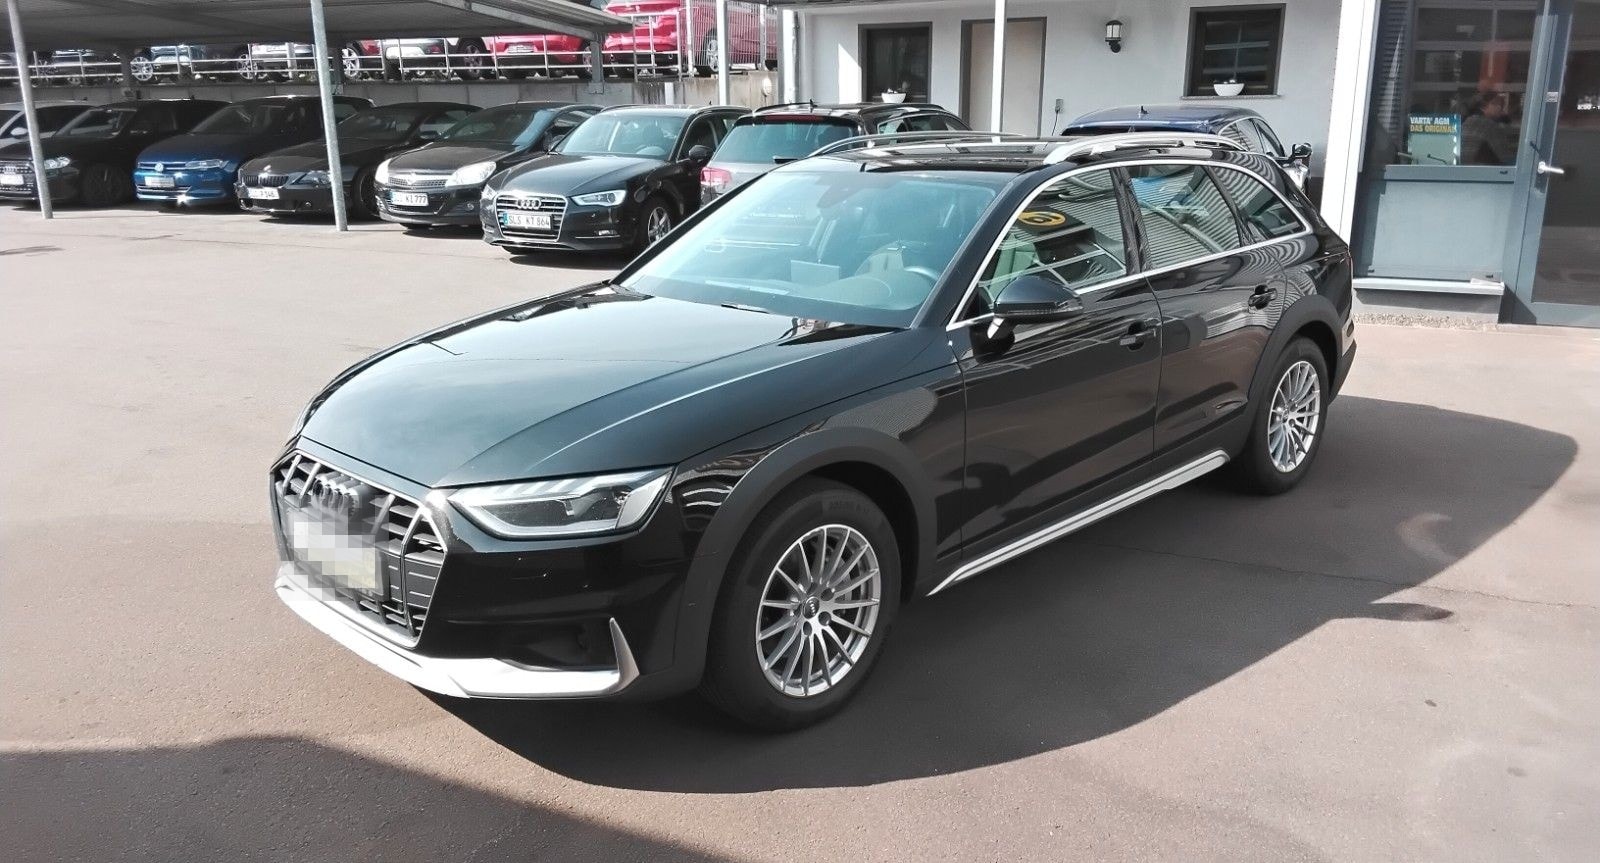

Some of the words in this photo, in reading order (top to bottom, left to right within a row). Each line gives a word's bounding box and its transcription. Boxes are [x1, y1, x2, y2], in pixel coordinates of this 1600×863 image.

[1434, 117, 1450, 125] AGM
[1410, 124, 1423, 132] DAS
[414, 195, 427, 204] 777
[508, 215, 522, 225] SLS
